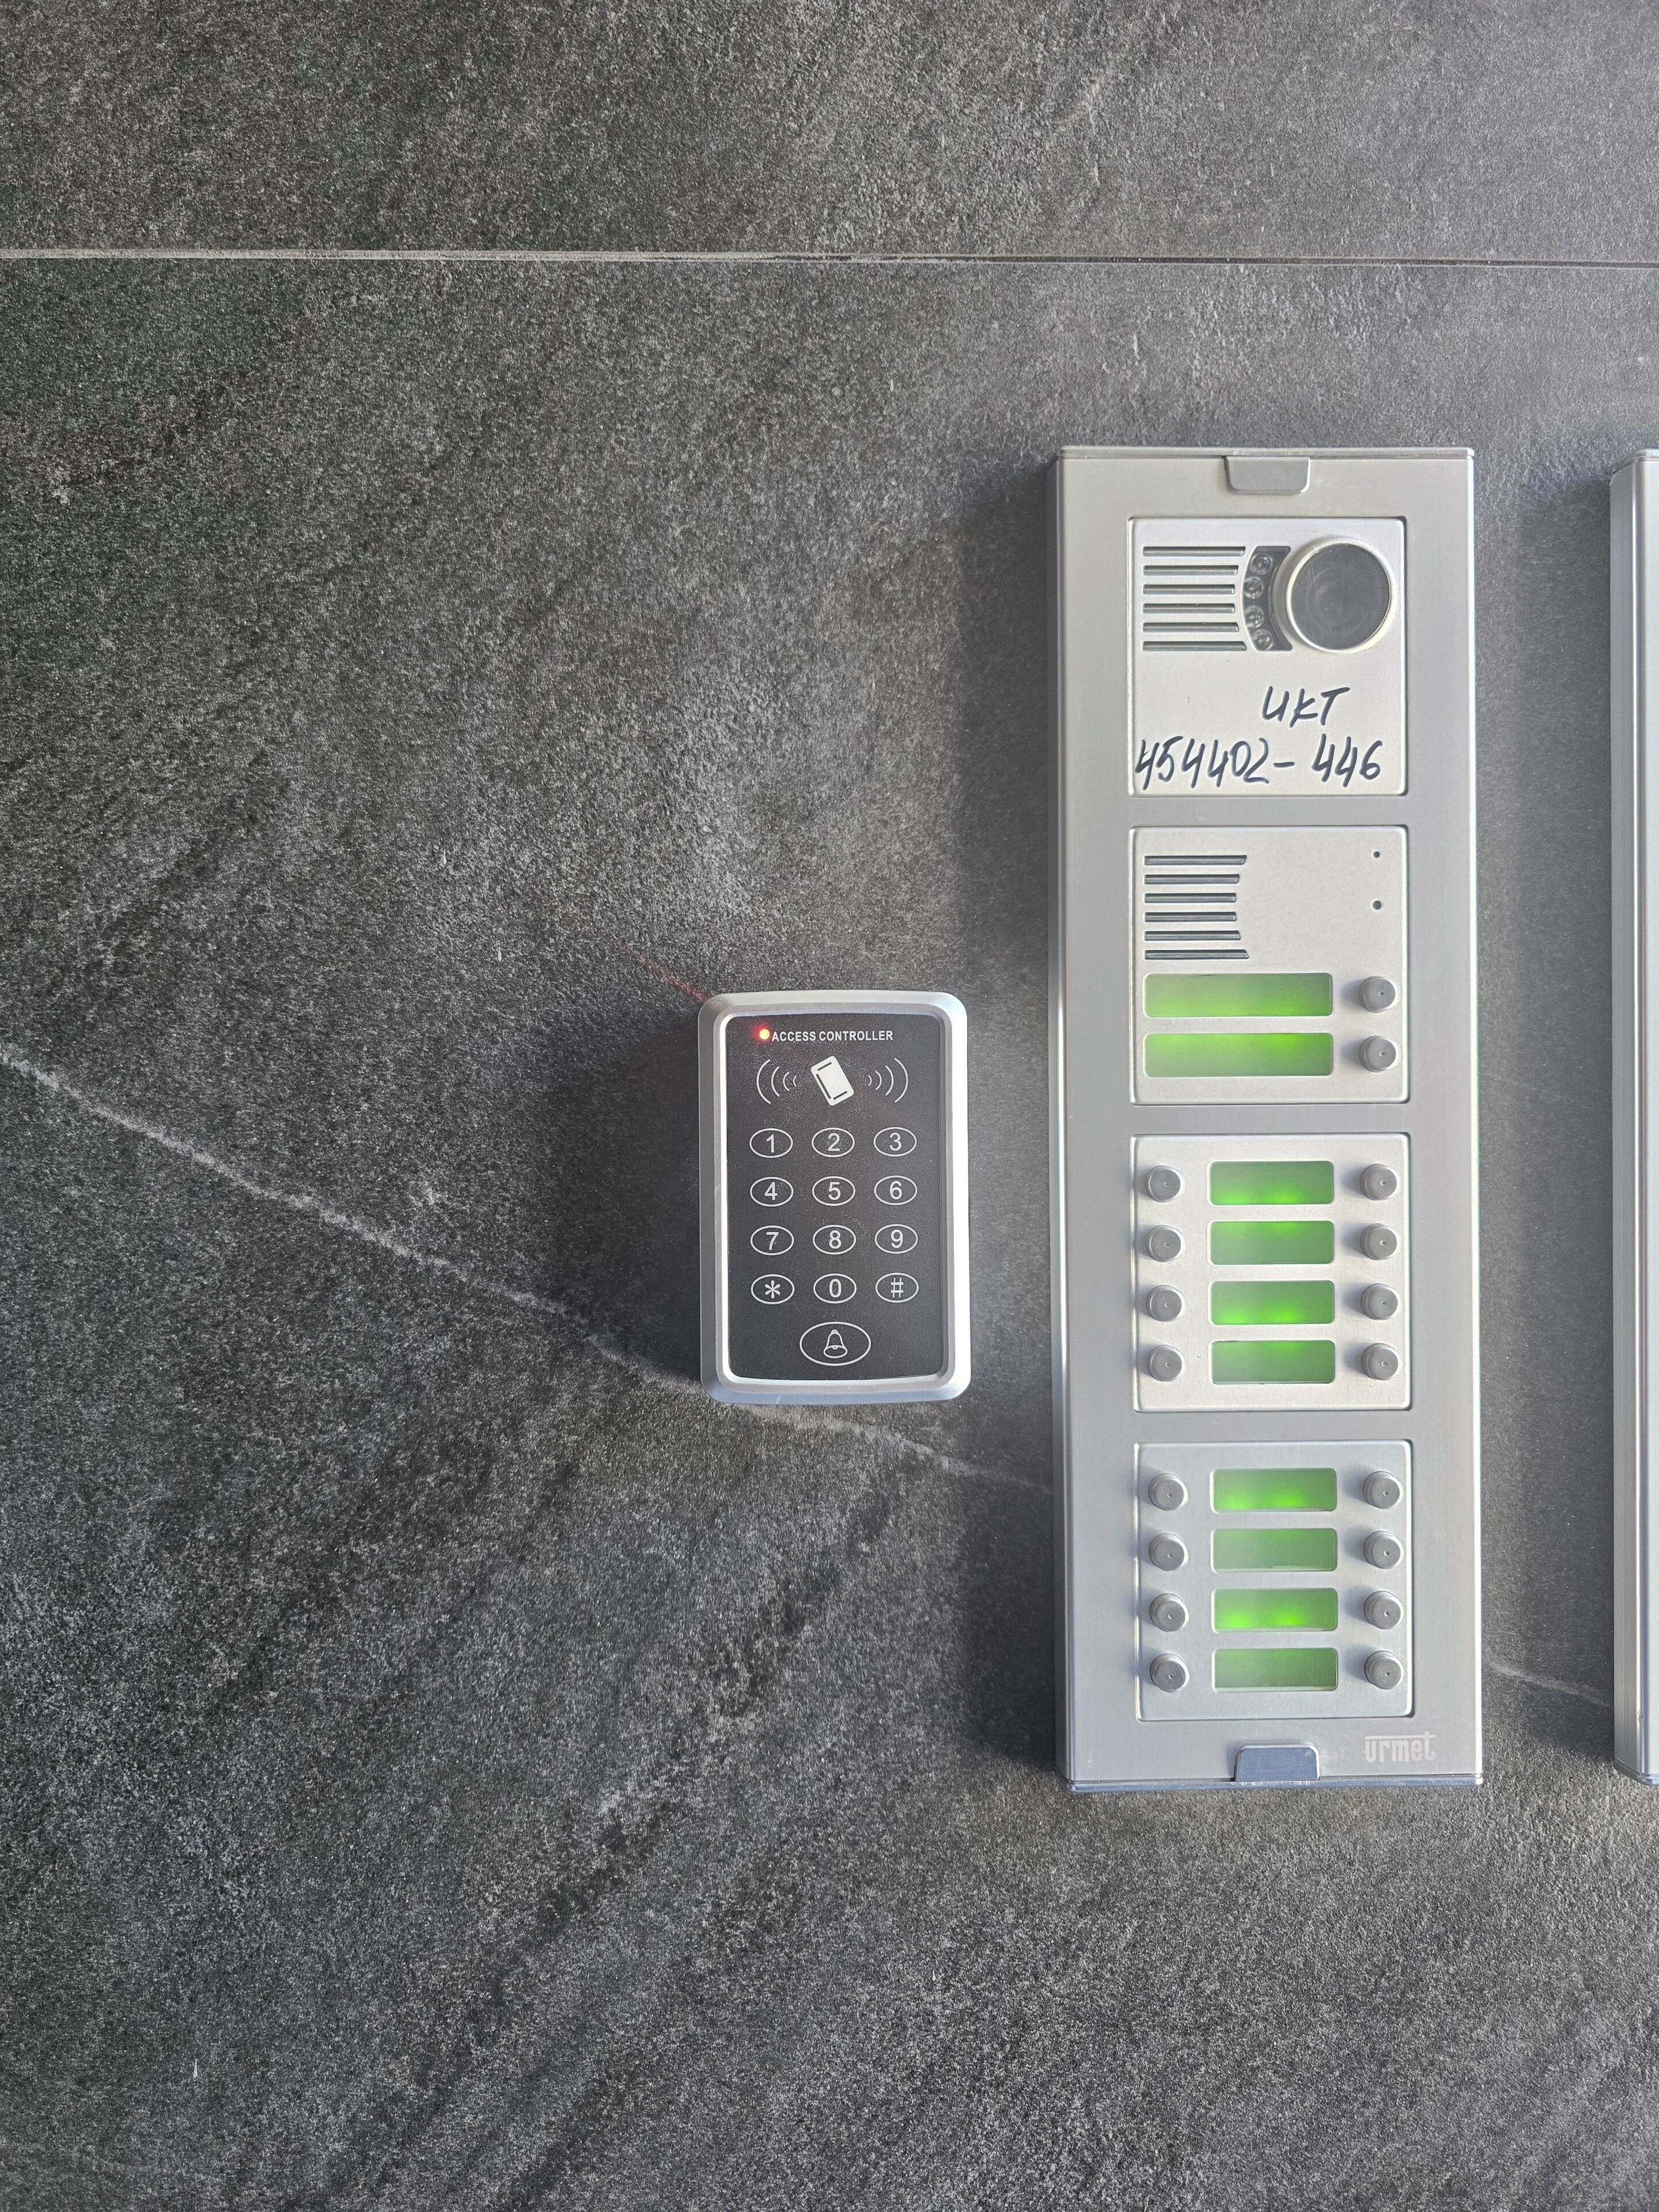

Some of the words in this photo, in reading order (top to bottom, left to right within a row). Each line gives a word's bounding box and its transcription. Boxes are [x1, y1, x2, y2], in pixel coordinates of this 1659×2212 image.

[771, 1032, 816, 1041] ACCESS
[819, 1031, 893, 1041] CONTROLLER
[766, 1134, 775, 1153] 1
[827, 1132, 840, 1152] 2
[889, 1132, 902, 1152] 3
[764, 1181, 778, 1200] 4
[828, 1181, 841, 1200] 5
[889, 1181, 903, 1200] 6
[766, 1232, 779, 1250] 7
[829, 1230, 842, 1249] 8
[891, 1229, 904, 1248] 9
[829, 1279, 842, 1298] 0
[891, 1277, 904, 1298] #
[1365, 1731, 1437, 1763] urmet
